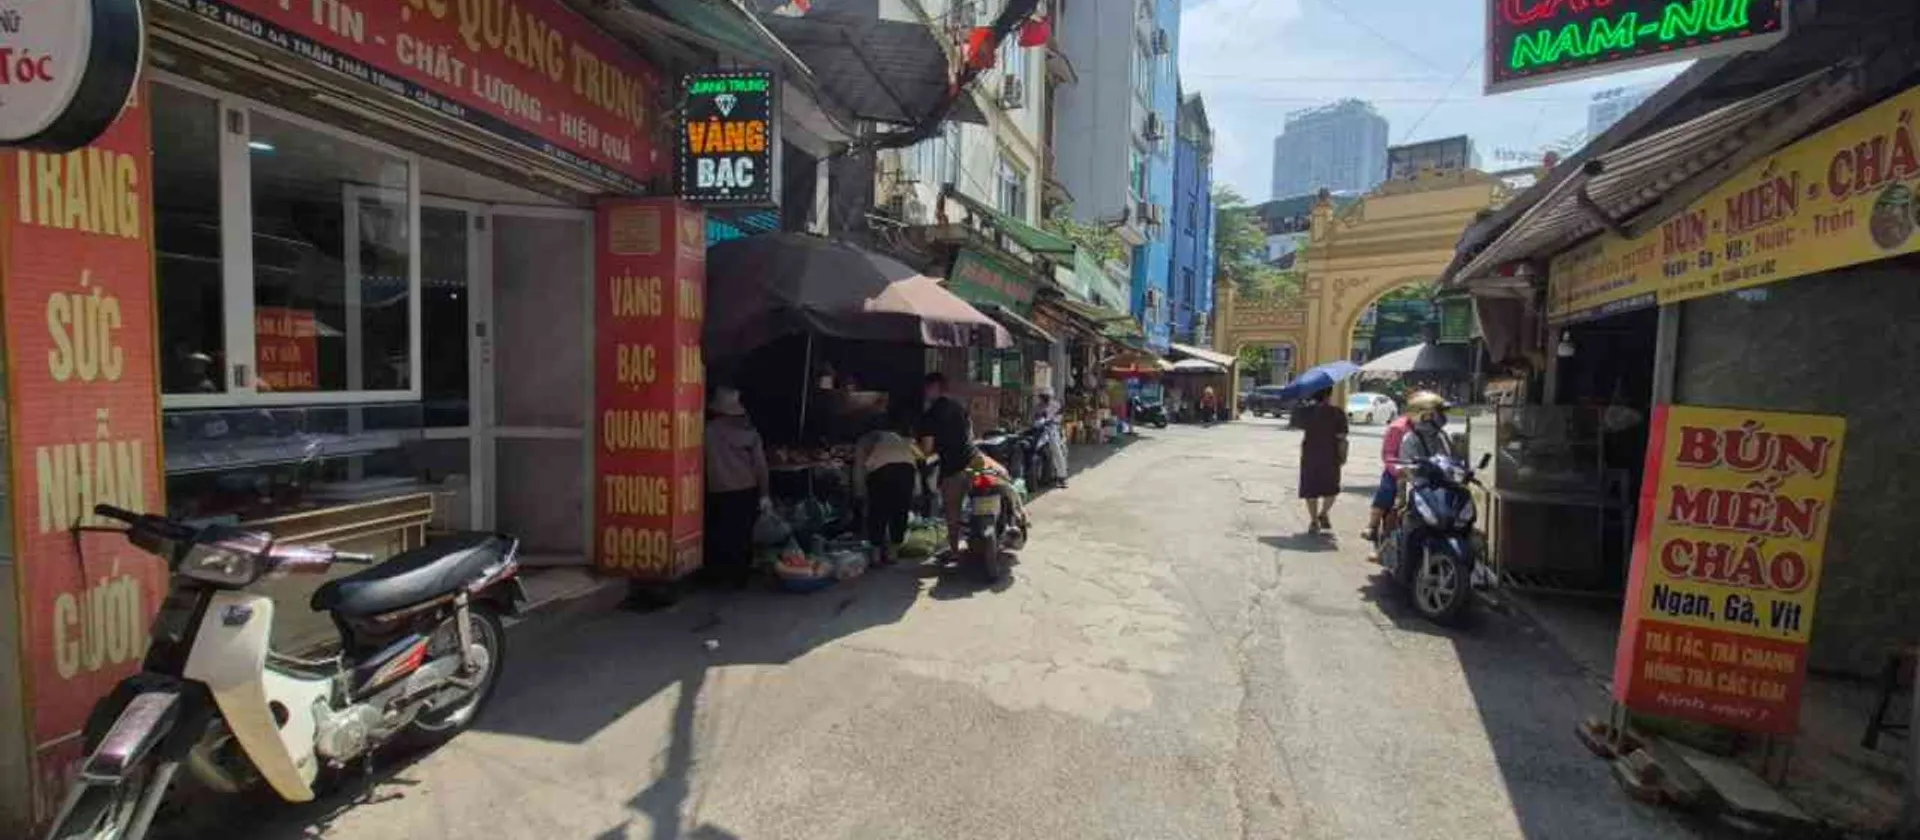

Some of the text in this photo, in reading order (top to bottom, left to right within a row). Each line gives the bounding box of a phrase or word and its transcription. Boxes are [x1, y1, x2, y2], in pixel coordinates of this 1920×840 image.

[396, 33, 466, 88] CHẤT
[471, 67, 542, 123] LƯỢNG
[560, 110, 600, 148] HIỆU
[571, 40, 646, 129] TRUNG
[687, 116, 766, 154] VÀNG
[697, 156, 755, 194] BẠC
[1724, 158, 1800, 237] MIẾN
[609, 265, 662, 317] VÀNG
[47, 268, 124, 383] SỨC
[617, 343, 656, 391] BẠC
[603, 408, 671, 452] QUANG
[1677, 419, 1835, 478] BÚN
[36, 408, 145, 534] NHẪN
[603, 474, 670, 517] TRUNG
[1668, 475, 1825, 541] MIẾN
[604, 524, 669, 573] 9999
[1660, 536, 1813, 592] CHÁO
[54, 556, 143, 681] CƯỚI
[1651, 583, 1802, 636] Ngan, Gà, Vịt
[1711, 640, 1738, 663] TRÀ
